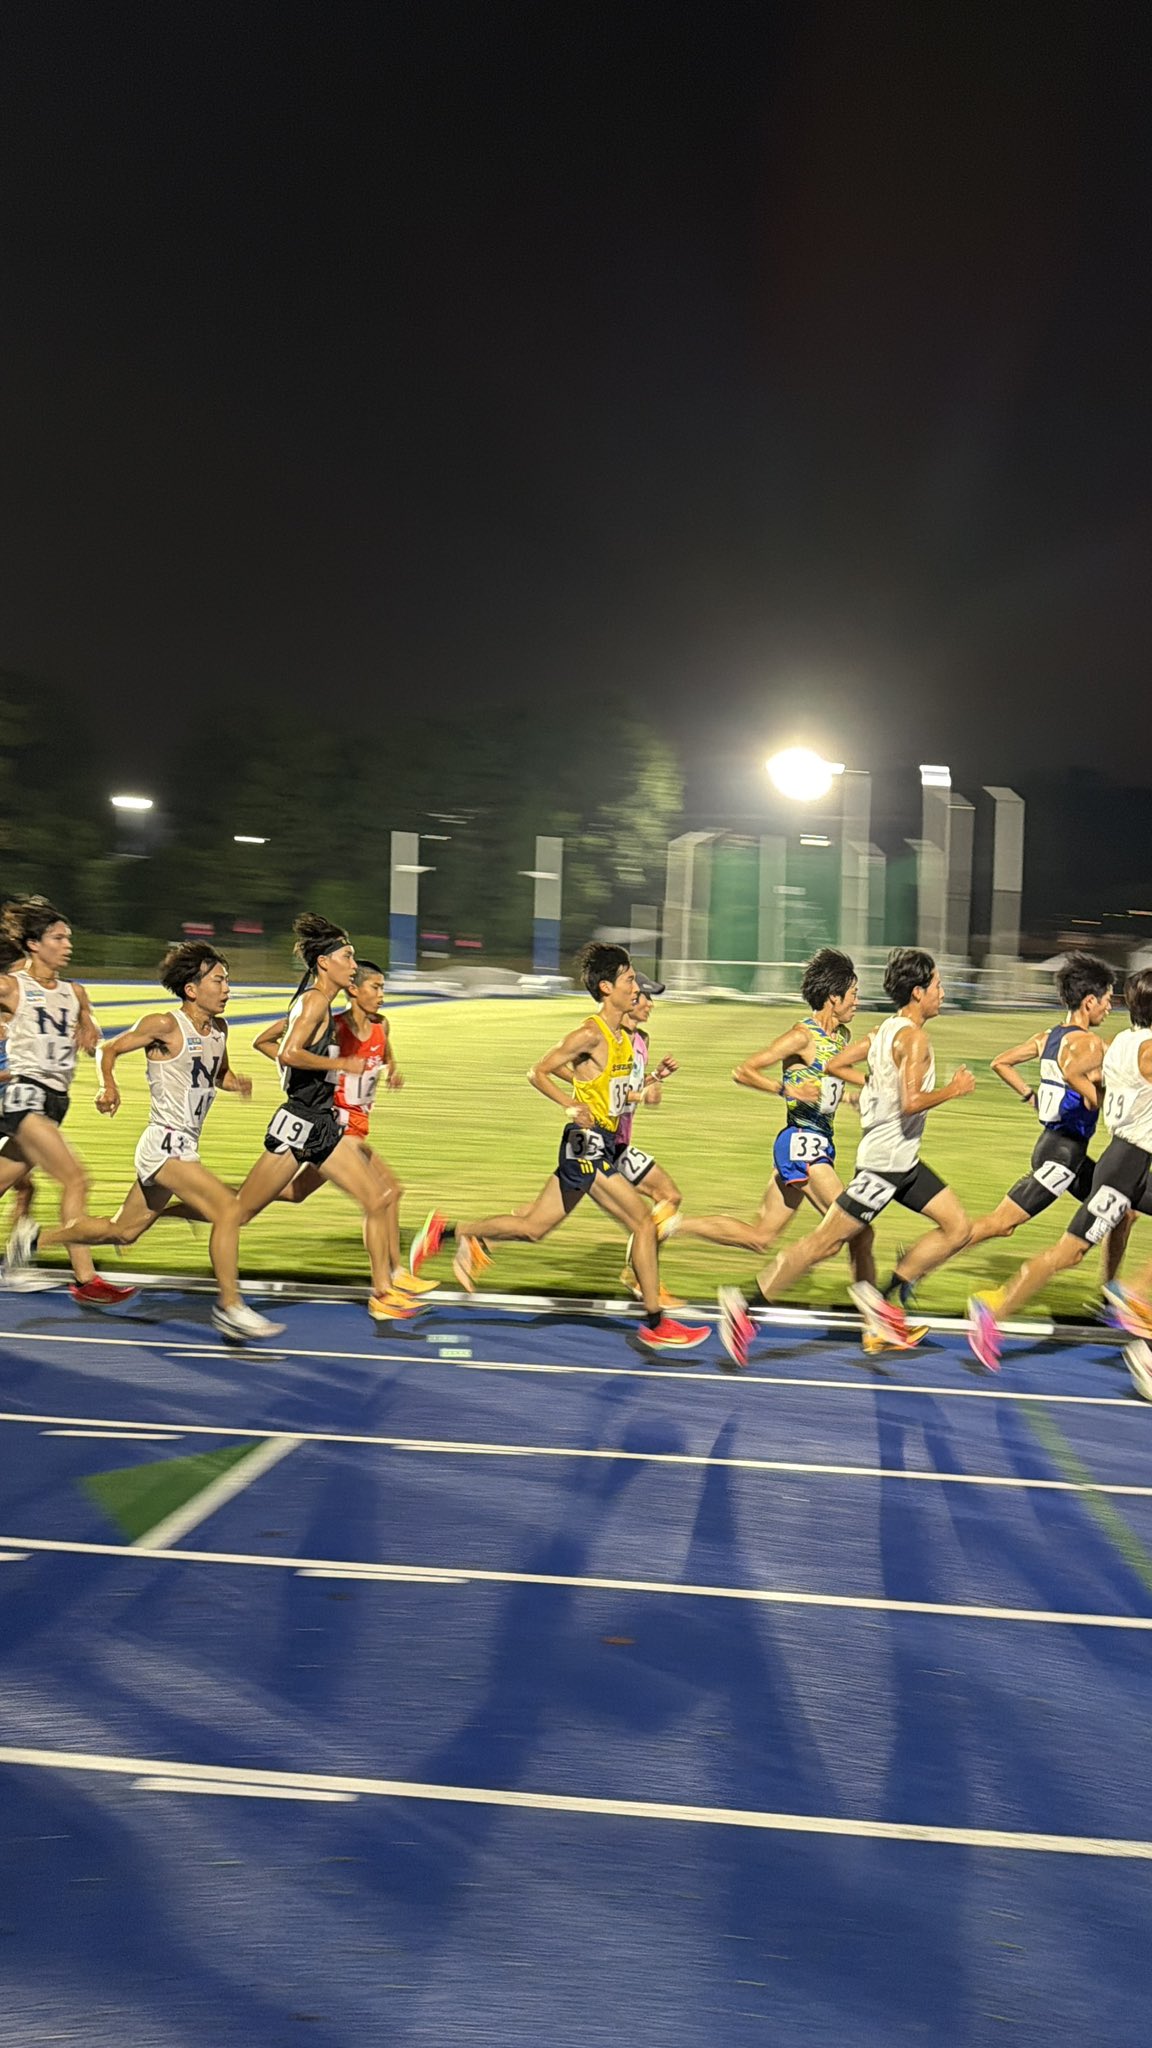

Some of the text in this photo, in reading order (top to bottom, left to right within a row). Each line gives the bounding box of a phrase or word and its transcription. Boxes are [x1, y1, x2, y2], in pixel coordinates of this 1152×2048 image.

[34, 1007, 68, 1036] N
[191, 1056, 220, 1088] N
[357, 1076, 376, 1098] 12
[1039, 1090, 1053, 1114] 17
[1106, 1092, 1125, 1119] 39
[277, 1115, 303, 1142] 19
[572, 1133, 599, 1156] 35
[796, 1136, 822, 1156] 33
[621, 1147, 647, 1174] 25
[854, 1176, 887, 1201] 37
[1042, 1166, 1070, 1188] 17
